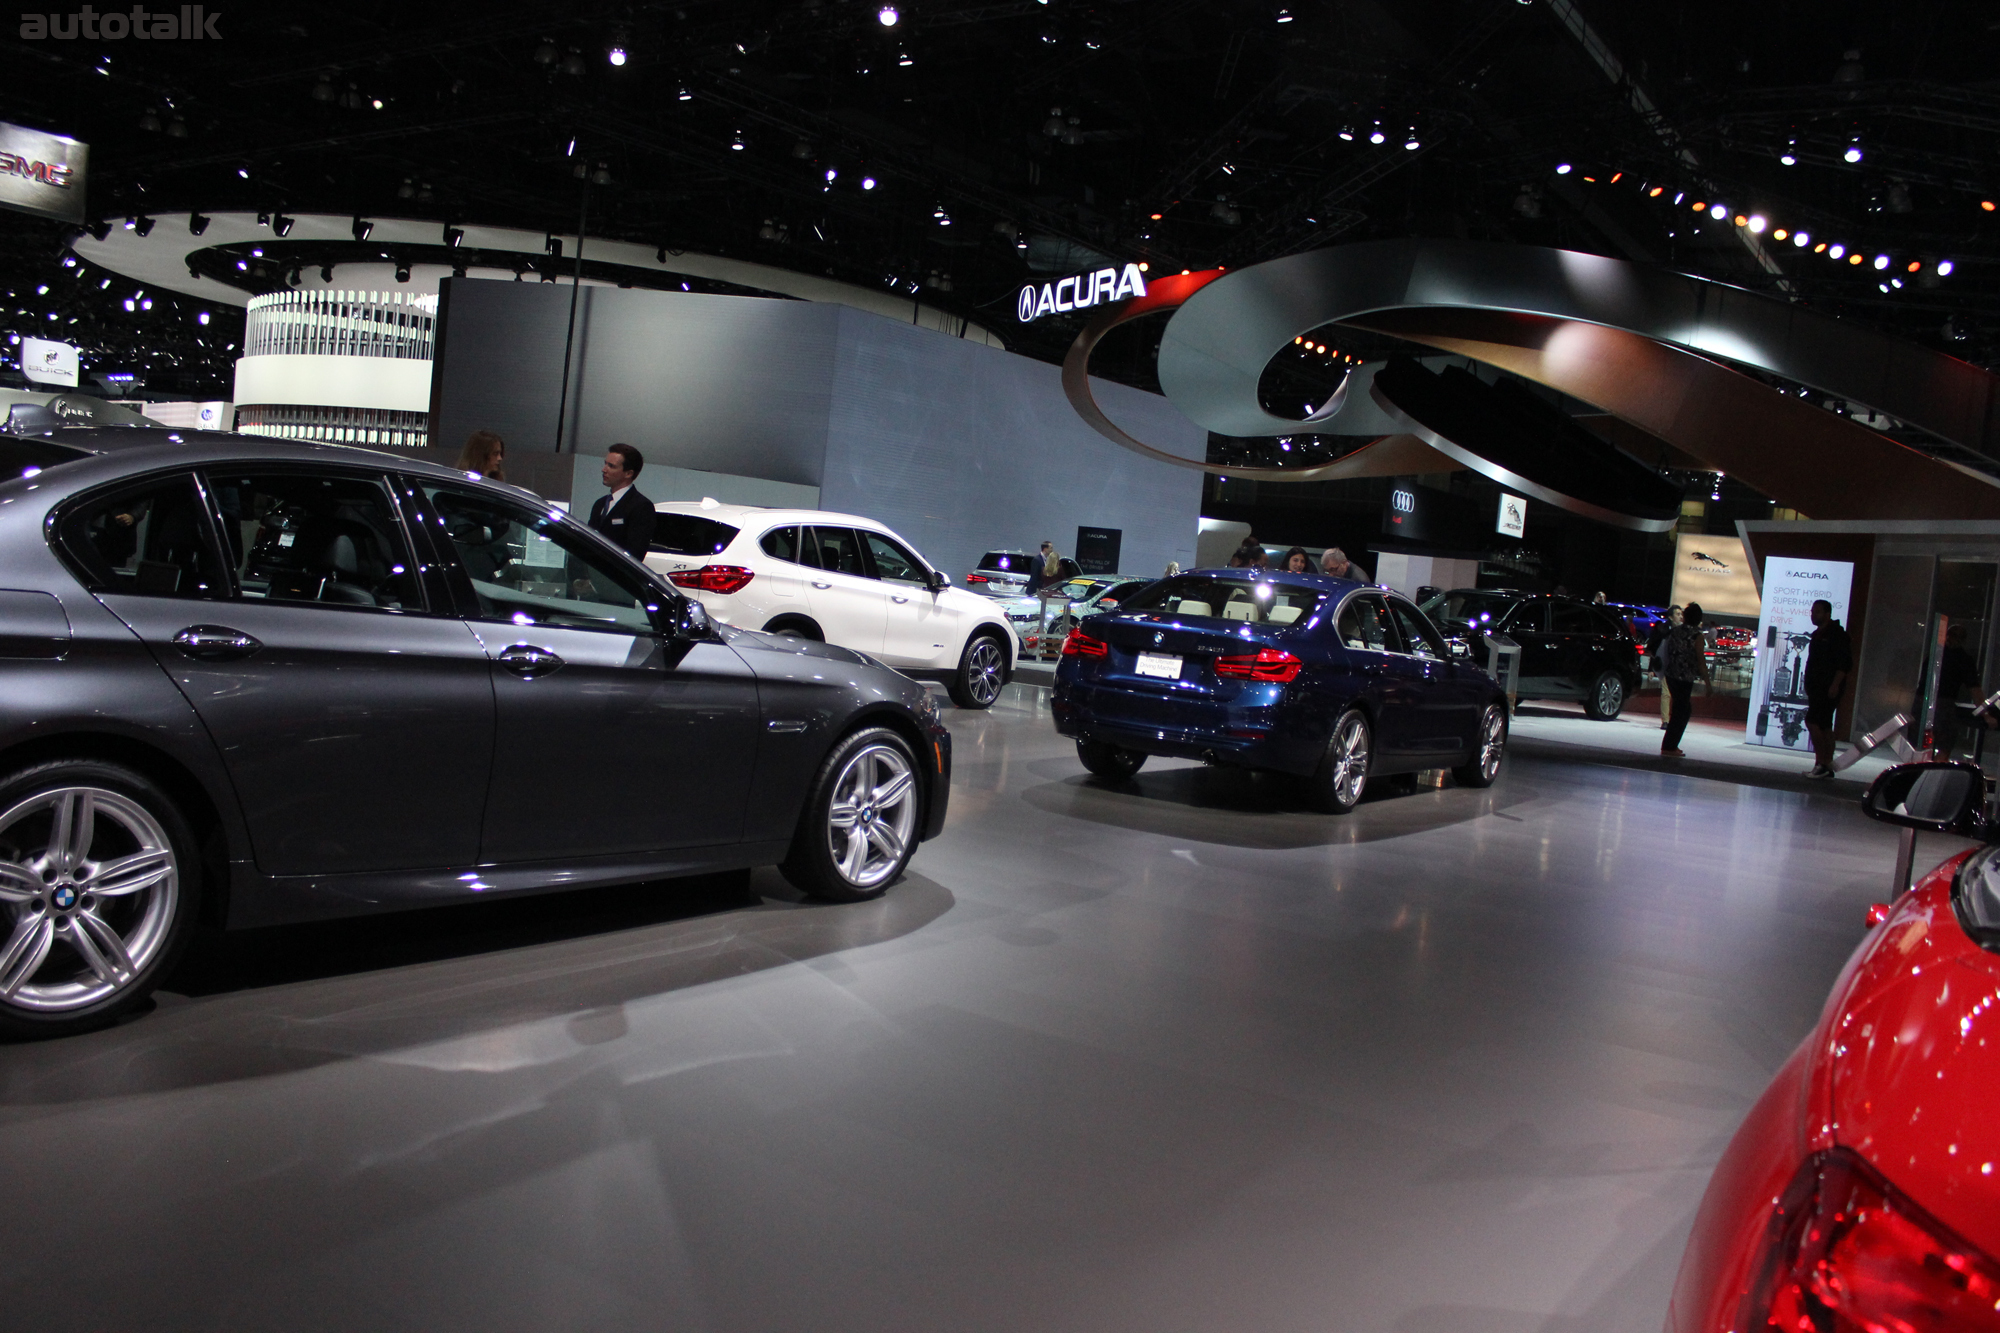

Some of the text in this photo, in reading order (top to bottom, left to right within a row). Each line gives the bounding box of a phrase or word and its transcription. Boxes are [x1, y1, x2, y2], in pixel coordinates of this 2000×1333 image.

[1035, 263, 1147, 317] ACURA
[28, 365, 74, 377] BUICK
[1688, 566, 1731, 574] JAGUAR
[1793, 571, 1829, 580] ACURA
[1773, 587, 1832, 598] SPORT HYBRID
[1773, 597, 1842, 609] SUPER HANNG
[1770, 616, 1793, 625] DRIVE
[1140, 661, 1177, 672] Driving Machine
